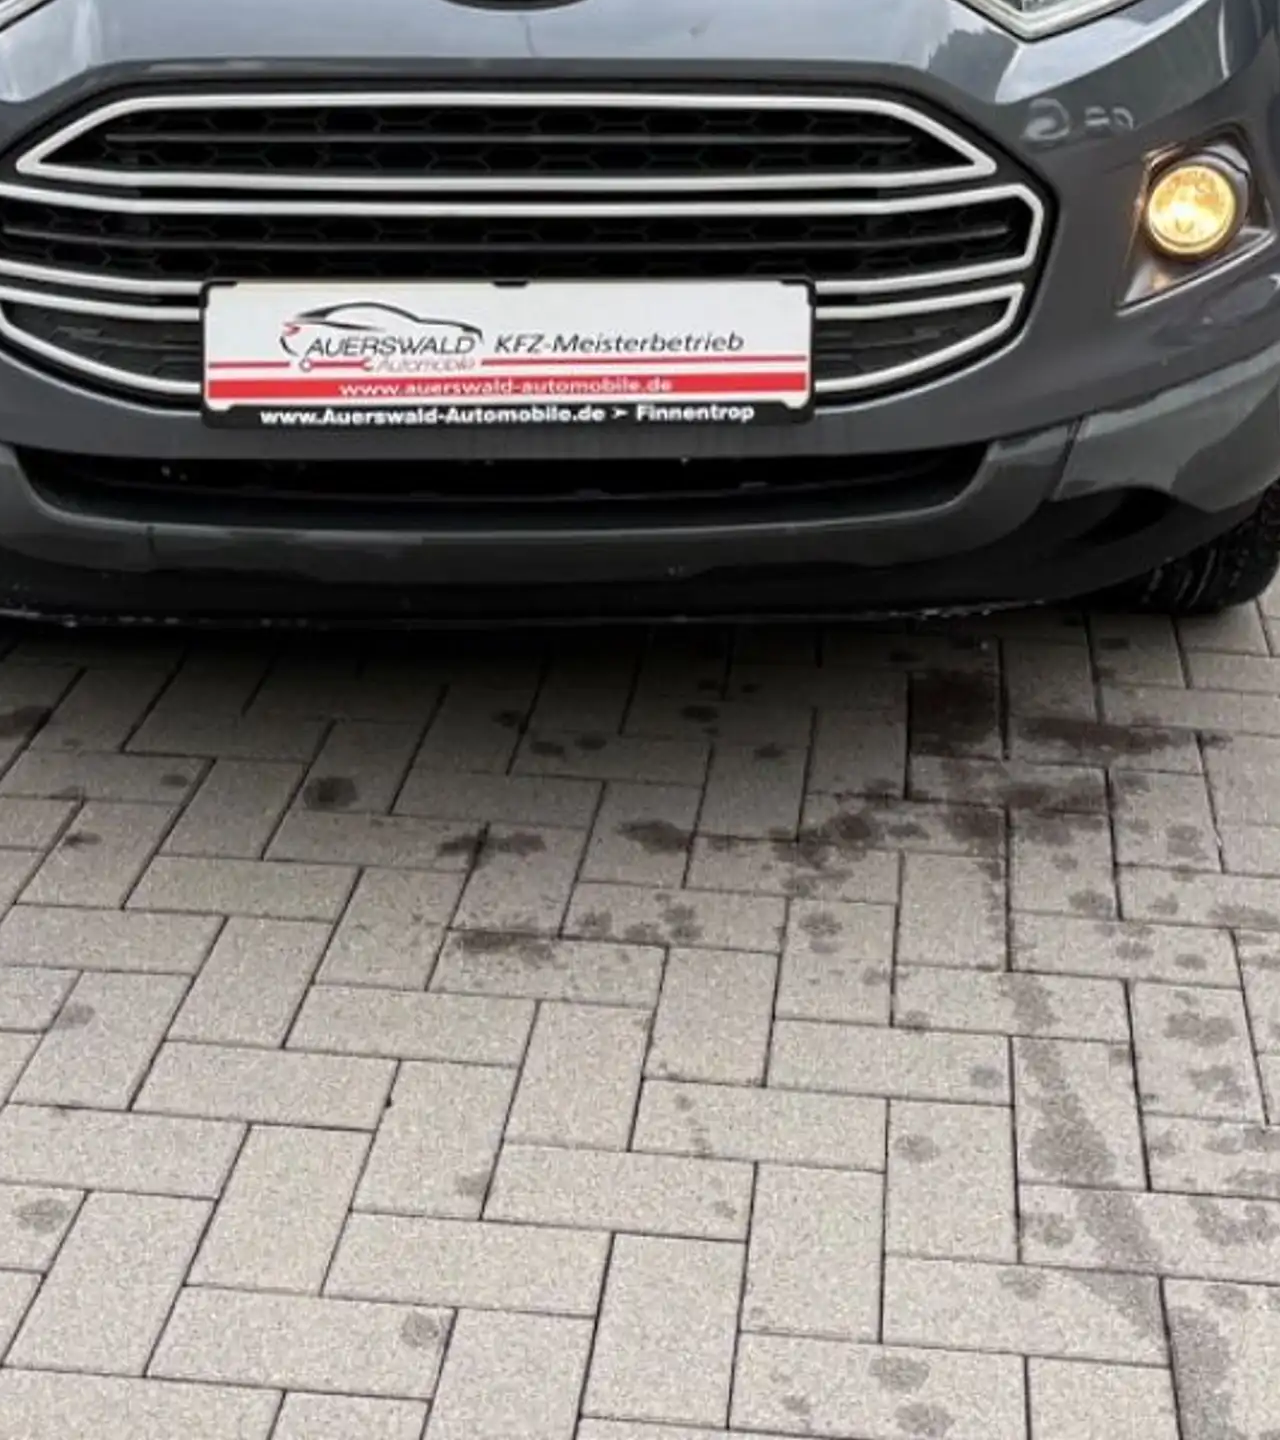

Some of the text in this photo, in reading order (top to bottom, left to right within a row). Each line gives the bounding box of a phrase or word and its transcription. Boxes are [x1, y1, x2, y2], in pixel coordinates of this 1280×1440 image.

[304, 333, 476, 357] AUERSWALD
[493, 330, 745, 355] KFZ-Meisterbetrieb
[338, 376, 674, 398] www.auerswald-automobile.de
[259, 403, 756, 426] www.Auerswald-Automobile.de Finnentrop
